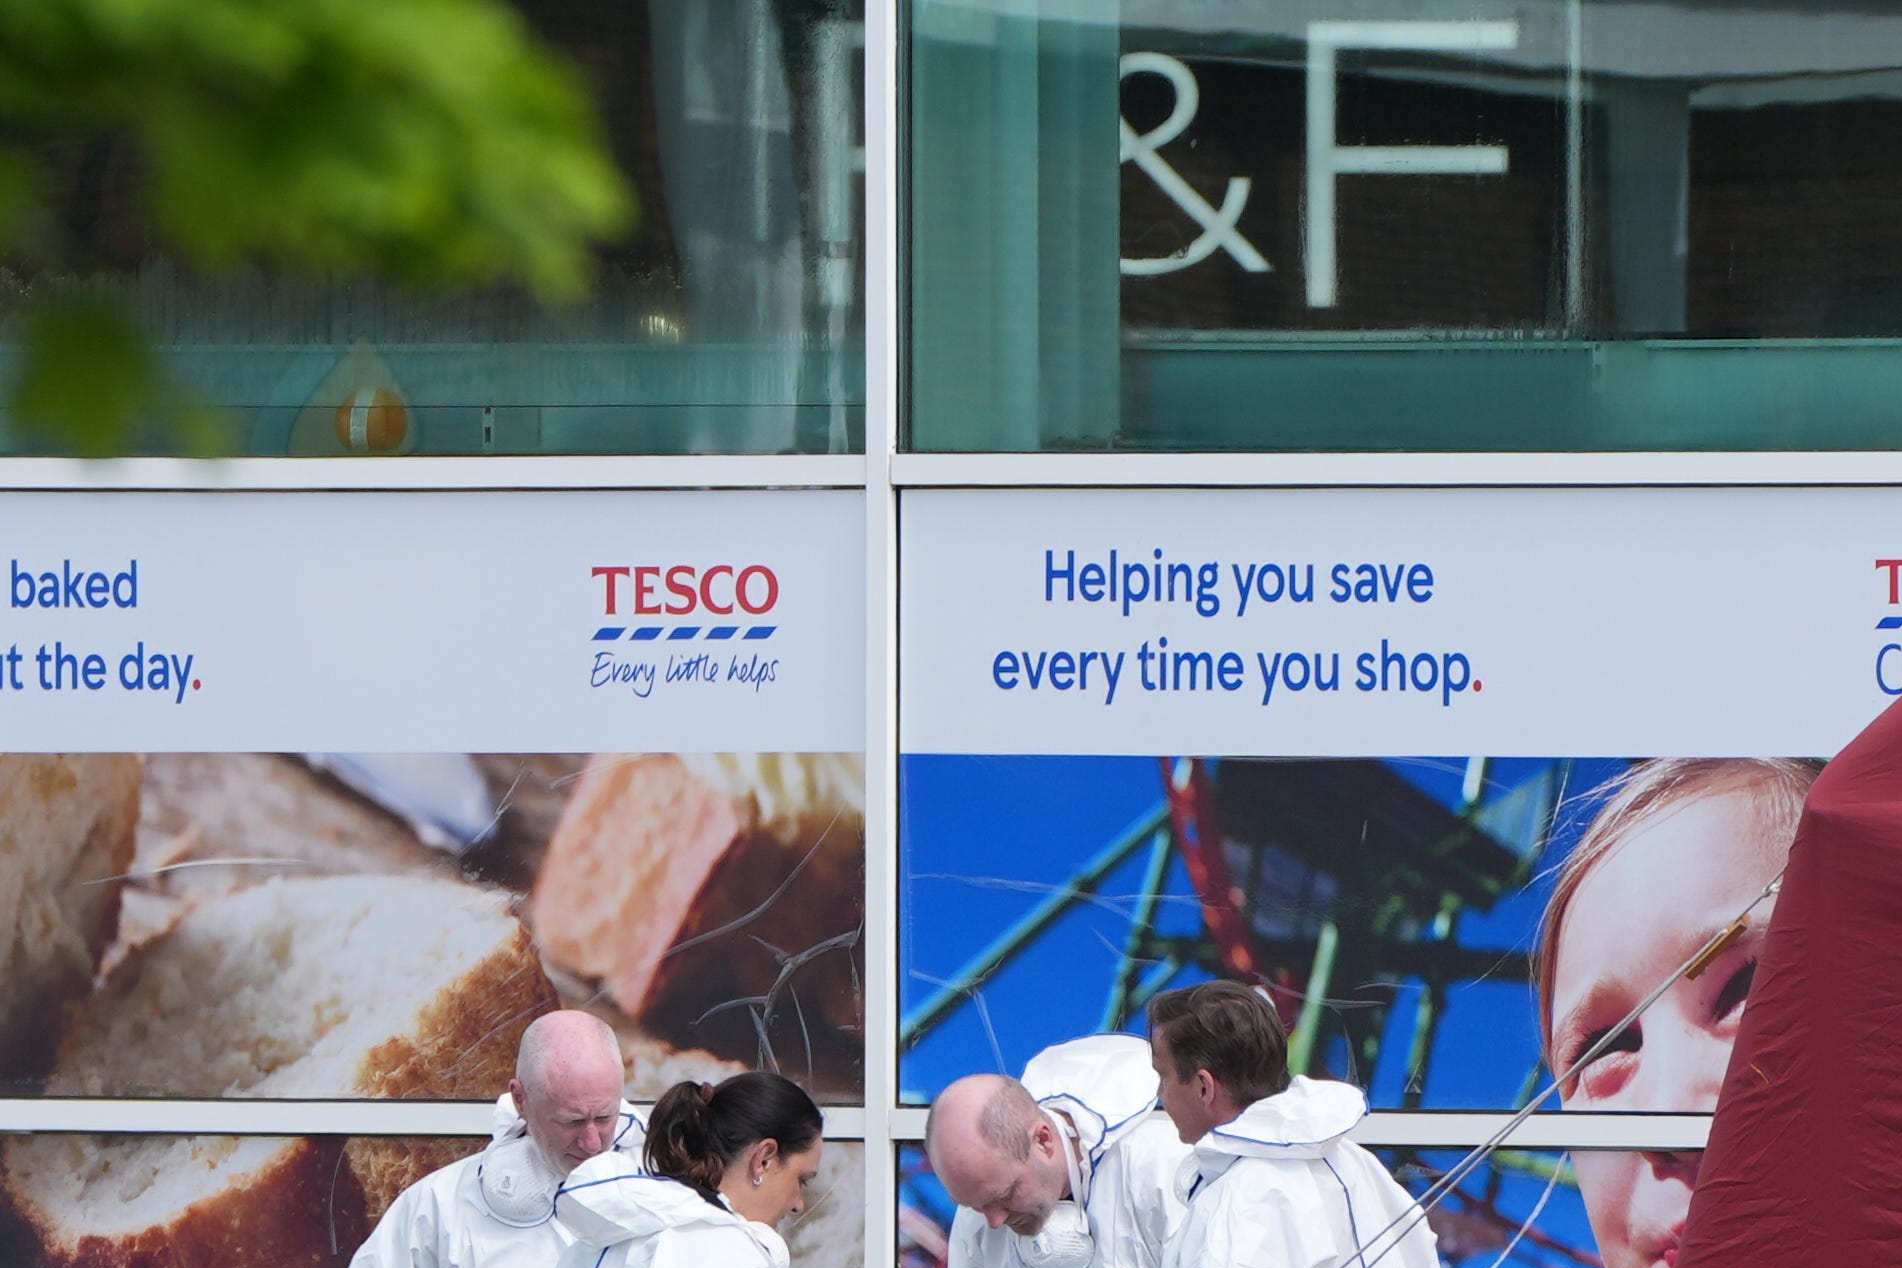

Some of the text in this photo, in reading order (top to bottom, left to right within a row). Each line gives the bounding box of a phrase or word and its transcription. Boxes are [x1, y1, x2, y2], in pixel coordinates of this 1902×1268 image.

[1120, 51, 1273, 275] &
[1306, 20, 1519, 308] F
[11, 559, 137, 608] baked
[592, 565, 779, 615] TESCO
[1046, 548, 1434, 617] Helping you save
[0, 641, 201, 704] t the day.
[590, 652, 780, 698] Every little helps
[992, 637, 1482, 706] every time you shop.
